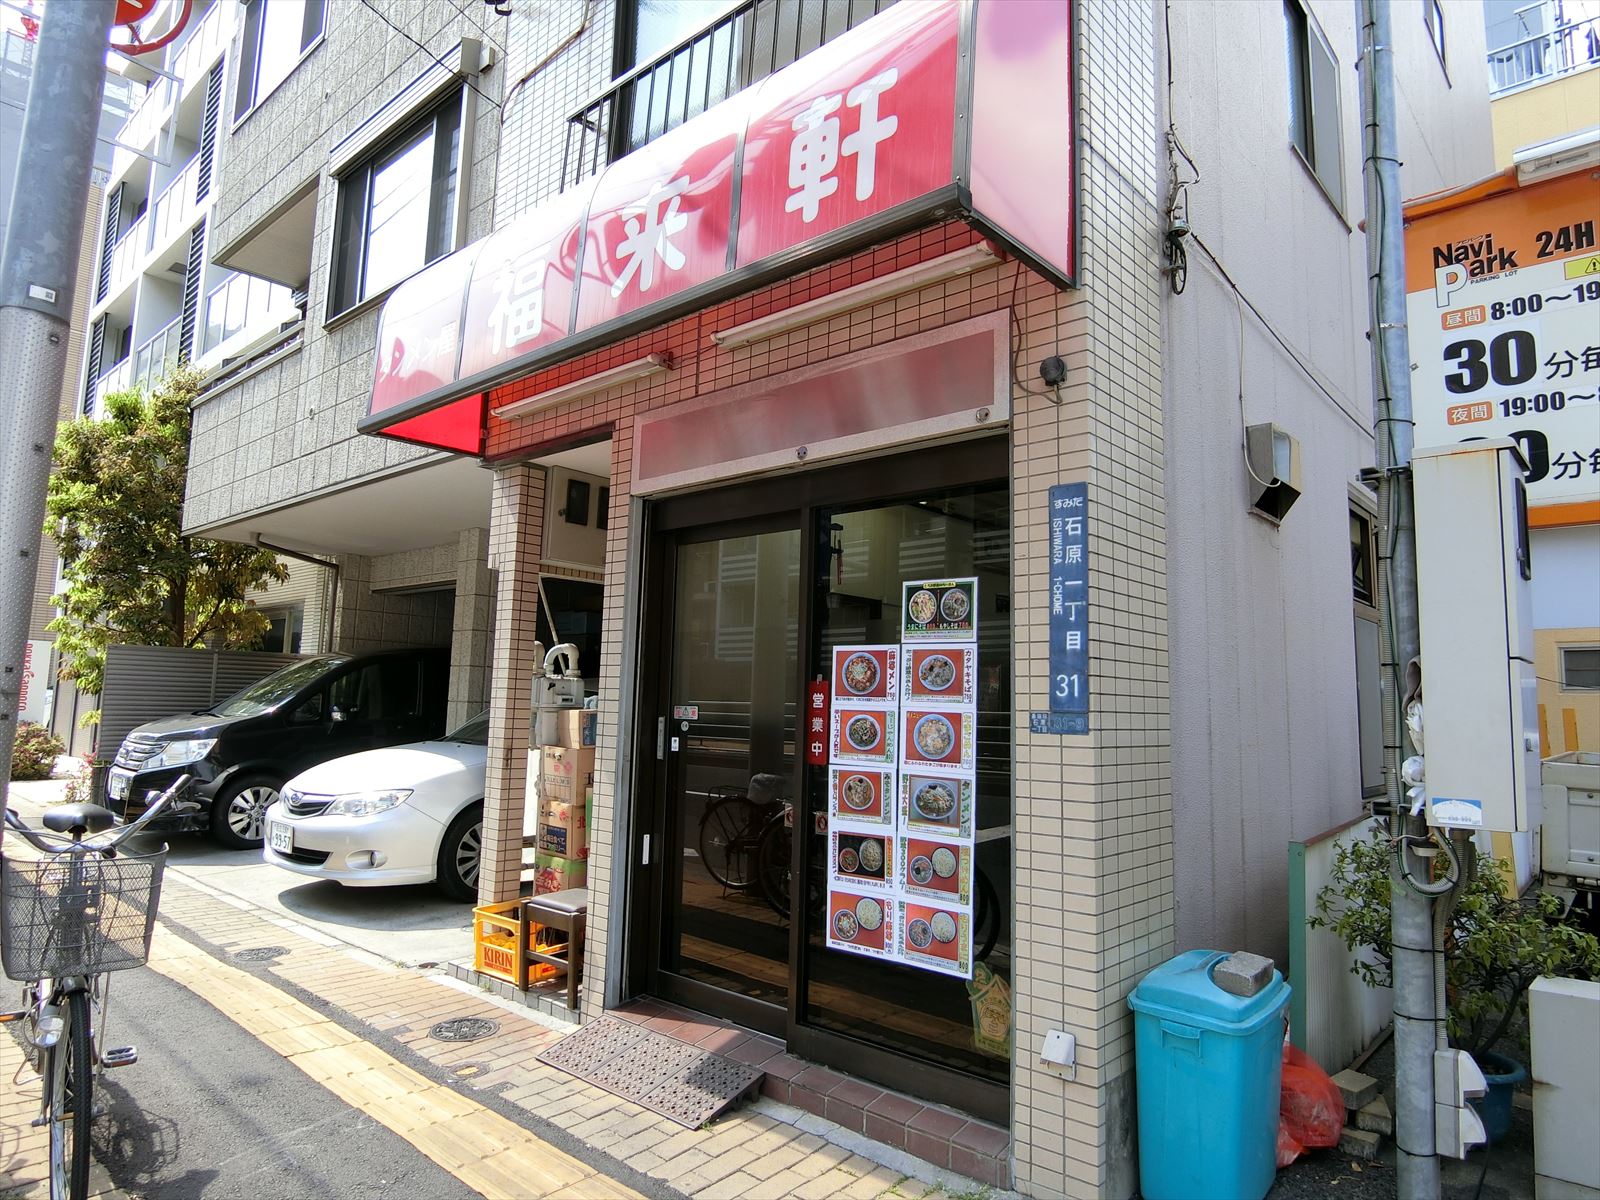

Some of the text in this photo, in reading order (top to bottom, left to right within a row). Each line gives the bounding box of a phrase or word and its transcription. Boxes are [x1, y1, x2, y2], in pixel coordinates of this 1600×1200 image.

[486, 67, 899, 356] 福来軒
[1433, 233, 1493, 269] Navi
[1535, 220, 1596, 259] 24H
[1435, 248, 1519, 308] Park
[1470, 269, 1519, 285] PARKING LOT
[1445, 307, 1481, 328] 昼間
[1451, 404, 1489, 423] 夜間
[1053, 496, 1084, 510] すみだ
[1053, 517, 1063, 616] ISHIWARA 1-CHOME
[1064, 516, 1083, 650] 石原一丁目
[1055, 674, 1079, 698] 31
[811, 692, 824, 757] 営業中
[960, 780, 971, 824] タンメン
[275, 833, 292, 850] 99-57
[484, 946, 512, 968] KIRIN
